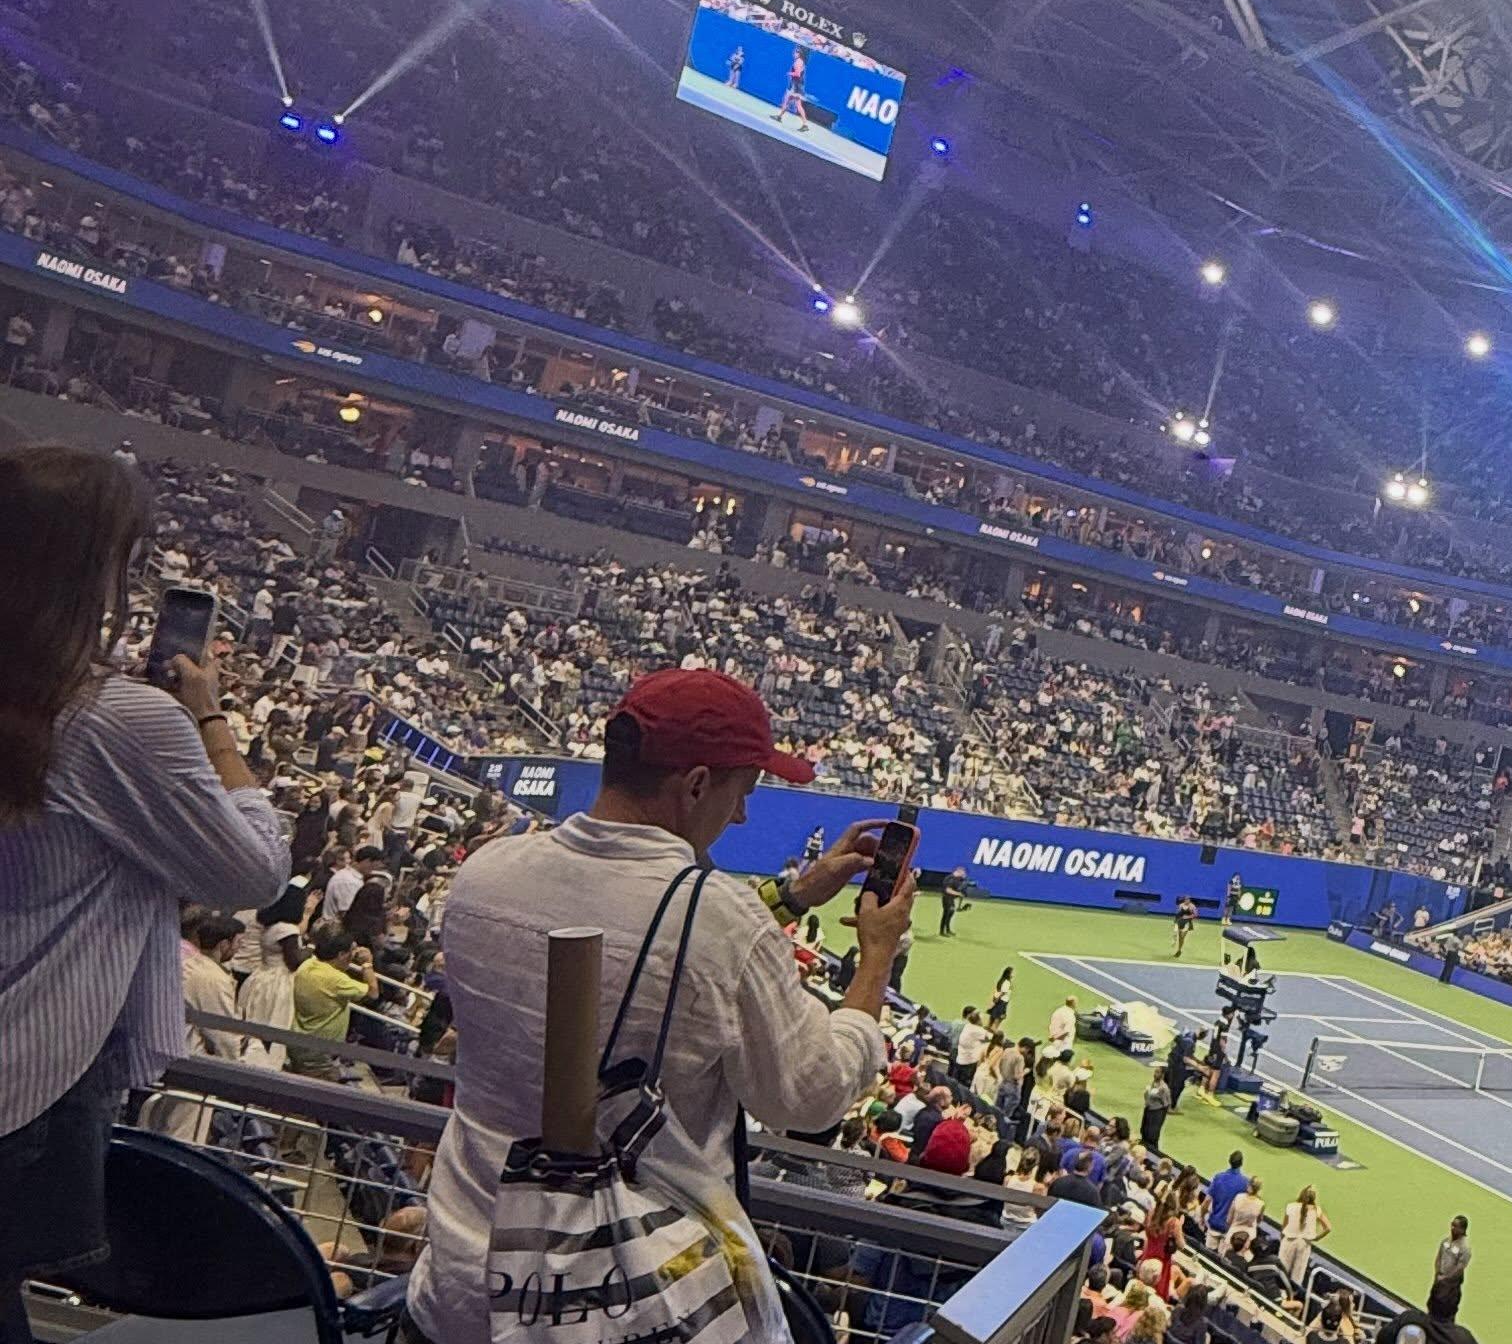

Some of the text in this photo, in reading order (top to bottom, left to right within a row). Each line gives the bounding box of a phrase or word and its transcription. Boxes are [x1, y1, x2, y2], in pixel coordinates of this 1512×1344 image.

[781, 0, 845, 40] ROLEX
[847, 86, 899, 124] NAO
[37, 253, 127, 293] NAOMI OSAKA
[556, 409, 639, 440] NAOMI OSAKA
[979, 523, 1039, 547] NAOMI OSAKA
[513, 779, 556, 796] OSAKA
[973, 837, 1146, 883] NAOMI OSAKA
[488, 1265, 632, 1327] POLO
